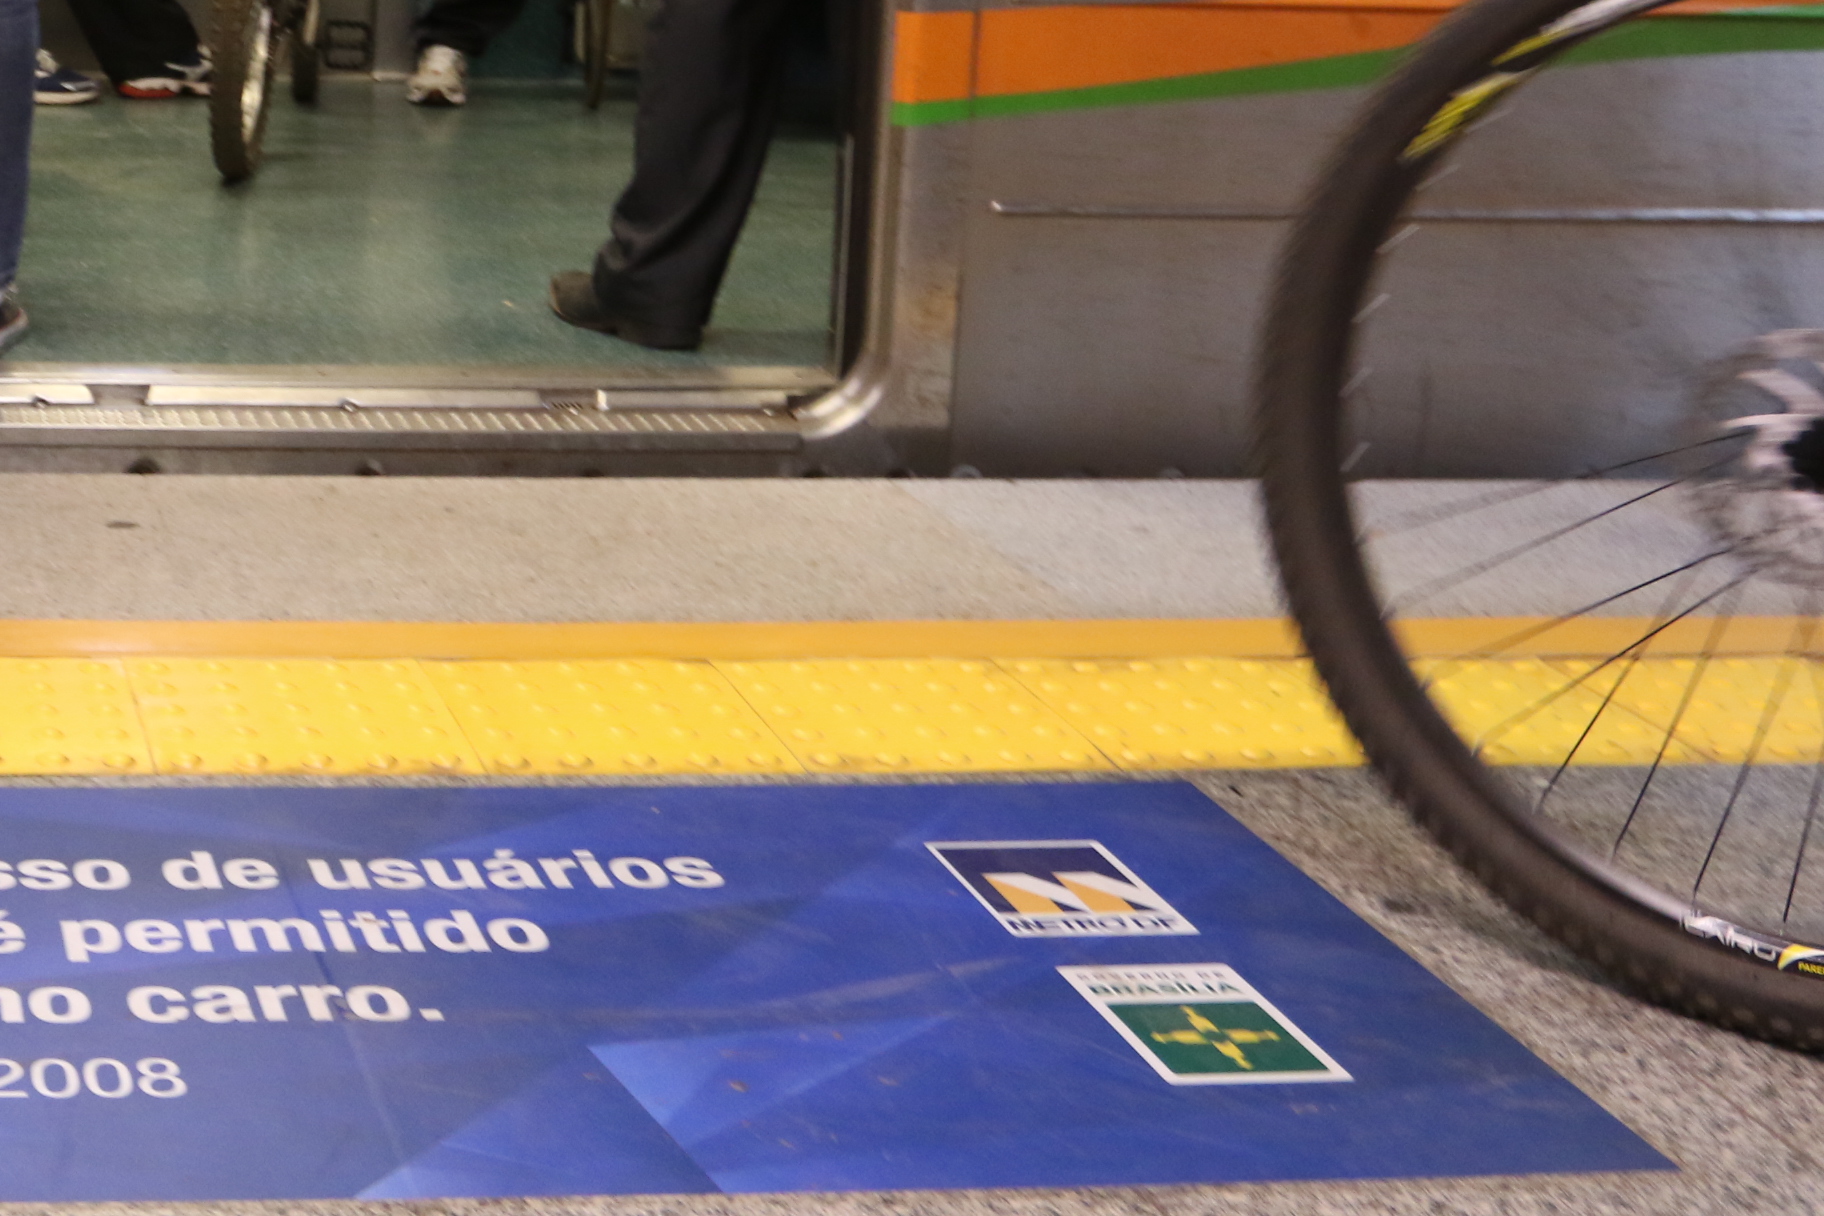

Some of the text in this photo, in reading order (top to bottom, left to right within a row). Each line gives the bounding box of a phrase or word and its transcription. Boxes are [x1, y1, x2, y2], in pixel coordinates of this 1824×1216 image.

[161, 850, 280, 891] de
[306, 848, 725, 891] usuários
[58, 909, 550, 964] permitido
[125, 984, 445, 1024] carro.
